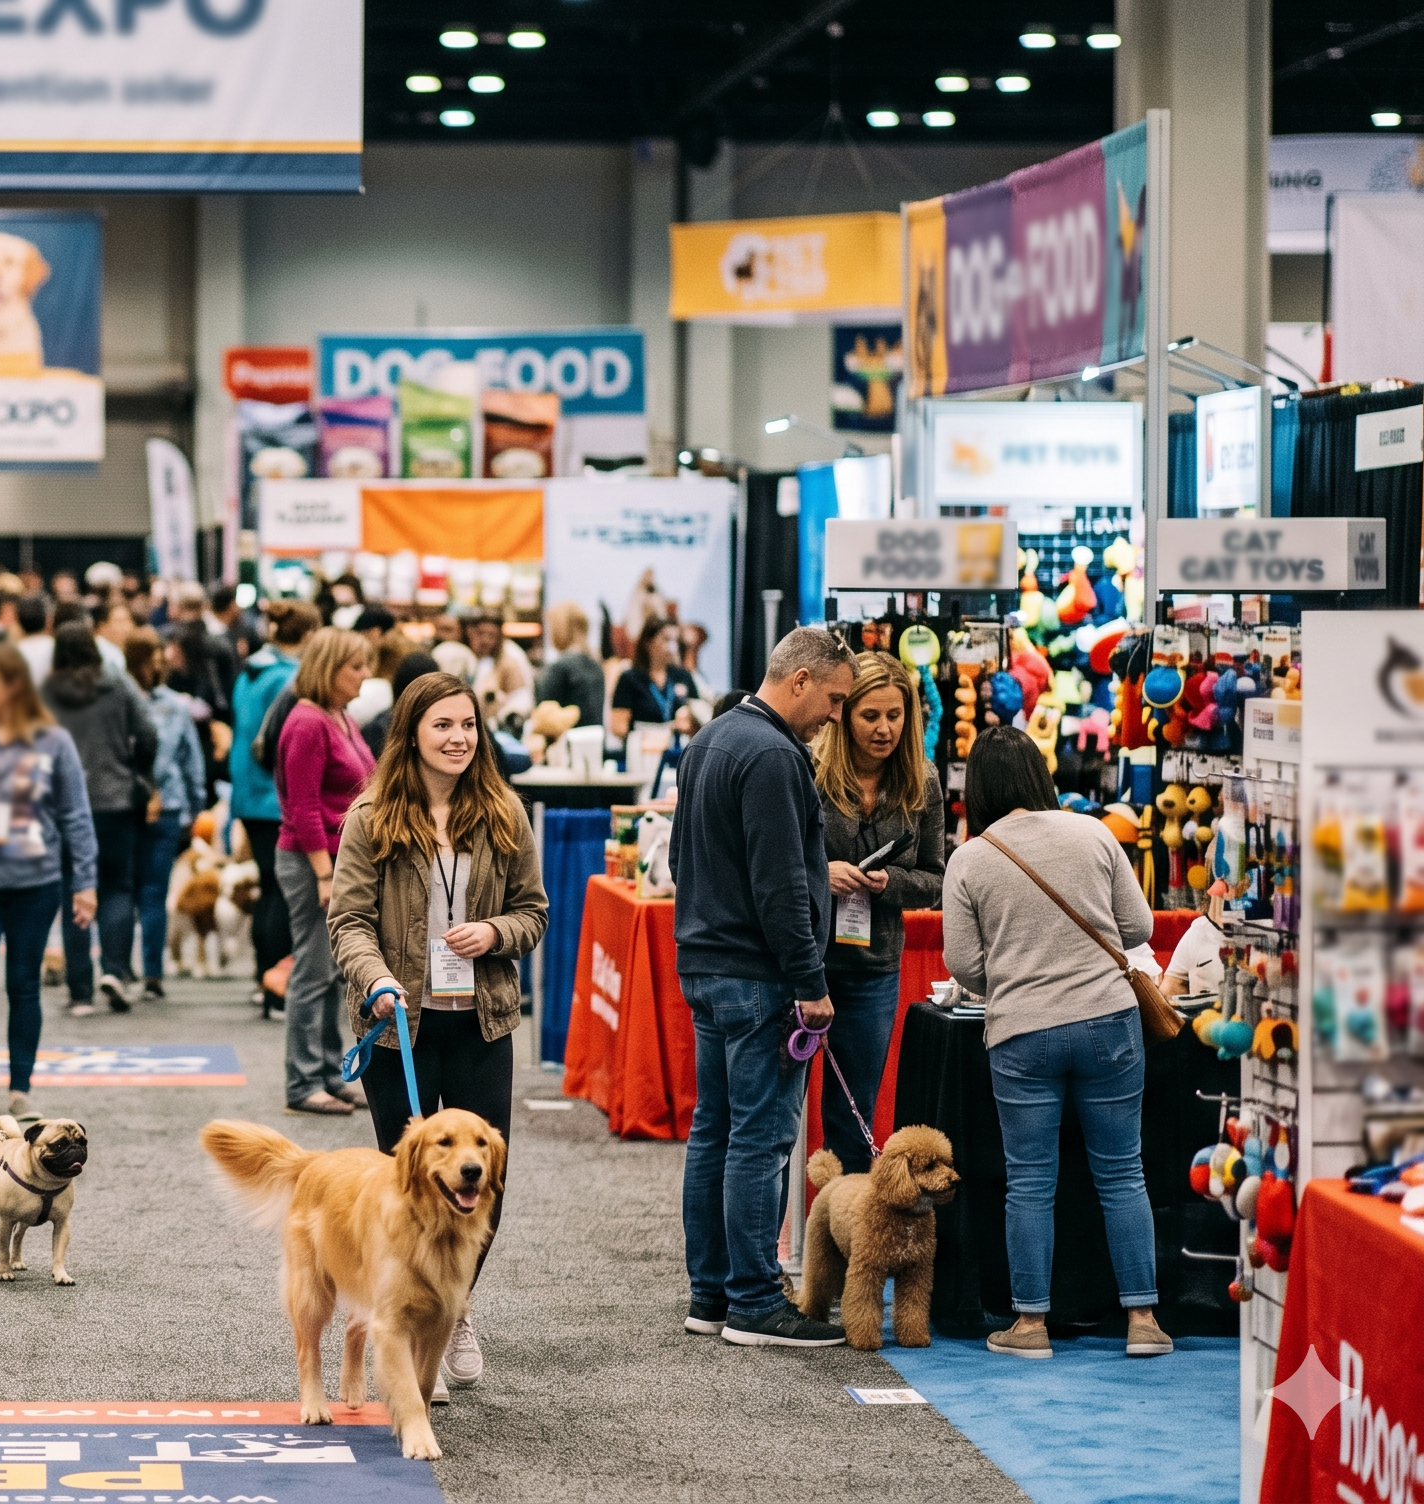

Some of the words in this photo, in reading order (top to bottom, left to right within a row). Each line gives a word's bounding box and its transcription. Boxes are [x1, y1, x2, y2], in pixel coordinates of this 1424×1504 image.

[949, 233, 1006, 345] DOG
[1027, 202, 1101, 331] FOOD
[476, 347, 633, 398] FOOD
[1002, 442, 1048, 465] PET
[1057, 442, 1120, 466] TOYS
[878, 529, 942, 553] DOG
[1222, 529, 1283, 554] CAT
[1357, 531, 1376, 555] CAT
[1179, 557, 1237, 583] CAT
[1247, 557, 1325, 583] TOYS
